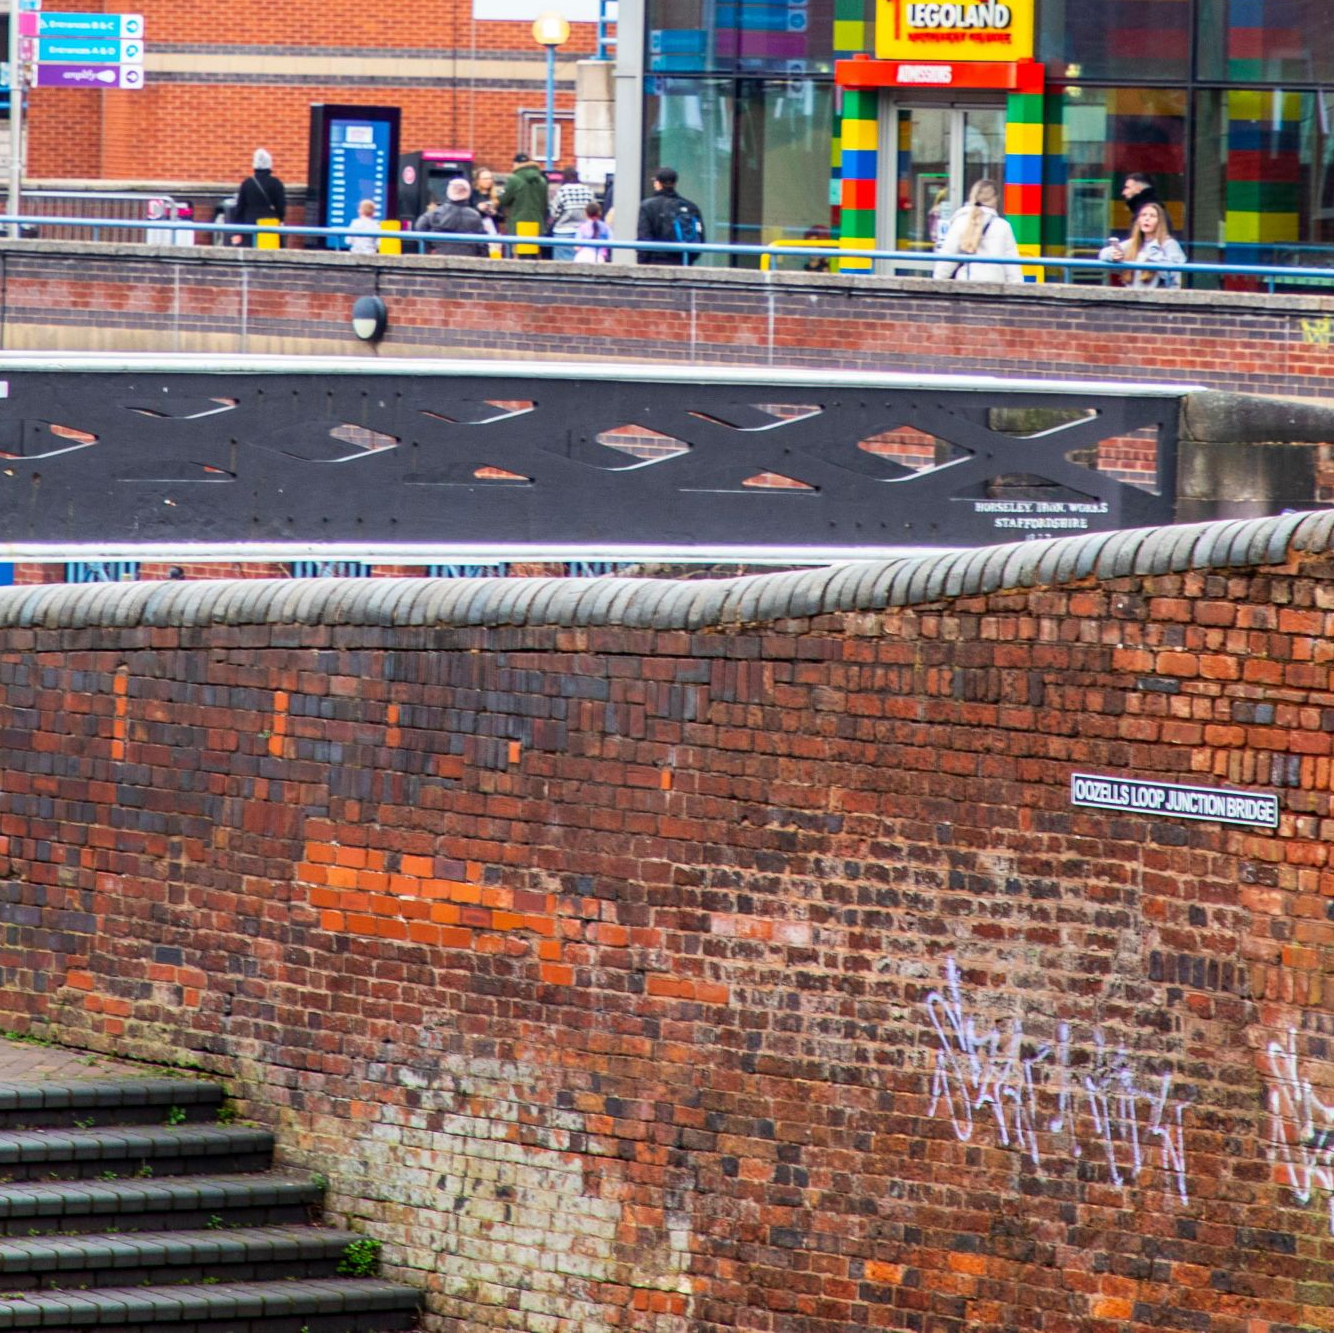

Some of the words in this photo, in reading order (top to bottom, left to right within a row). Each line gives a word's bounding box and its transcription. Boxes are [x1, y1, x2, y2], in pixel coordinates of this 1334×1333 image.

[1068, 503, 1109, 514] WORKS
[994, 517, 1089, 529] STAFFORDSHIRE
[1075, 779, 1130, 806] OOZELLS
[1131, 786, 1166, 809] LOOP
[1166, 790, 1227, 817] JUNCTION
[1227, 797, 1276, 822] BRIDGE
